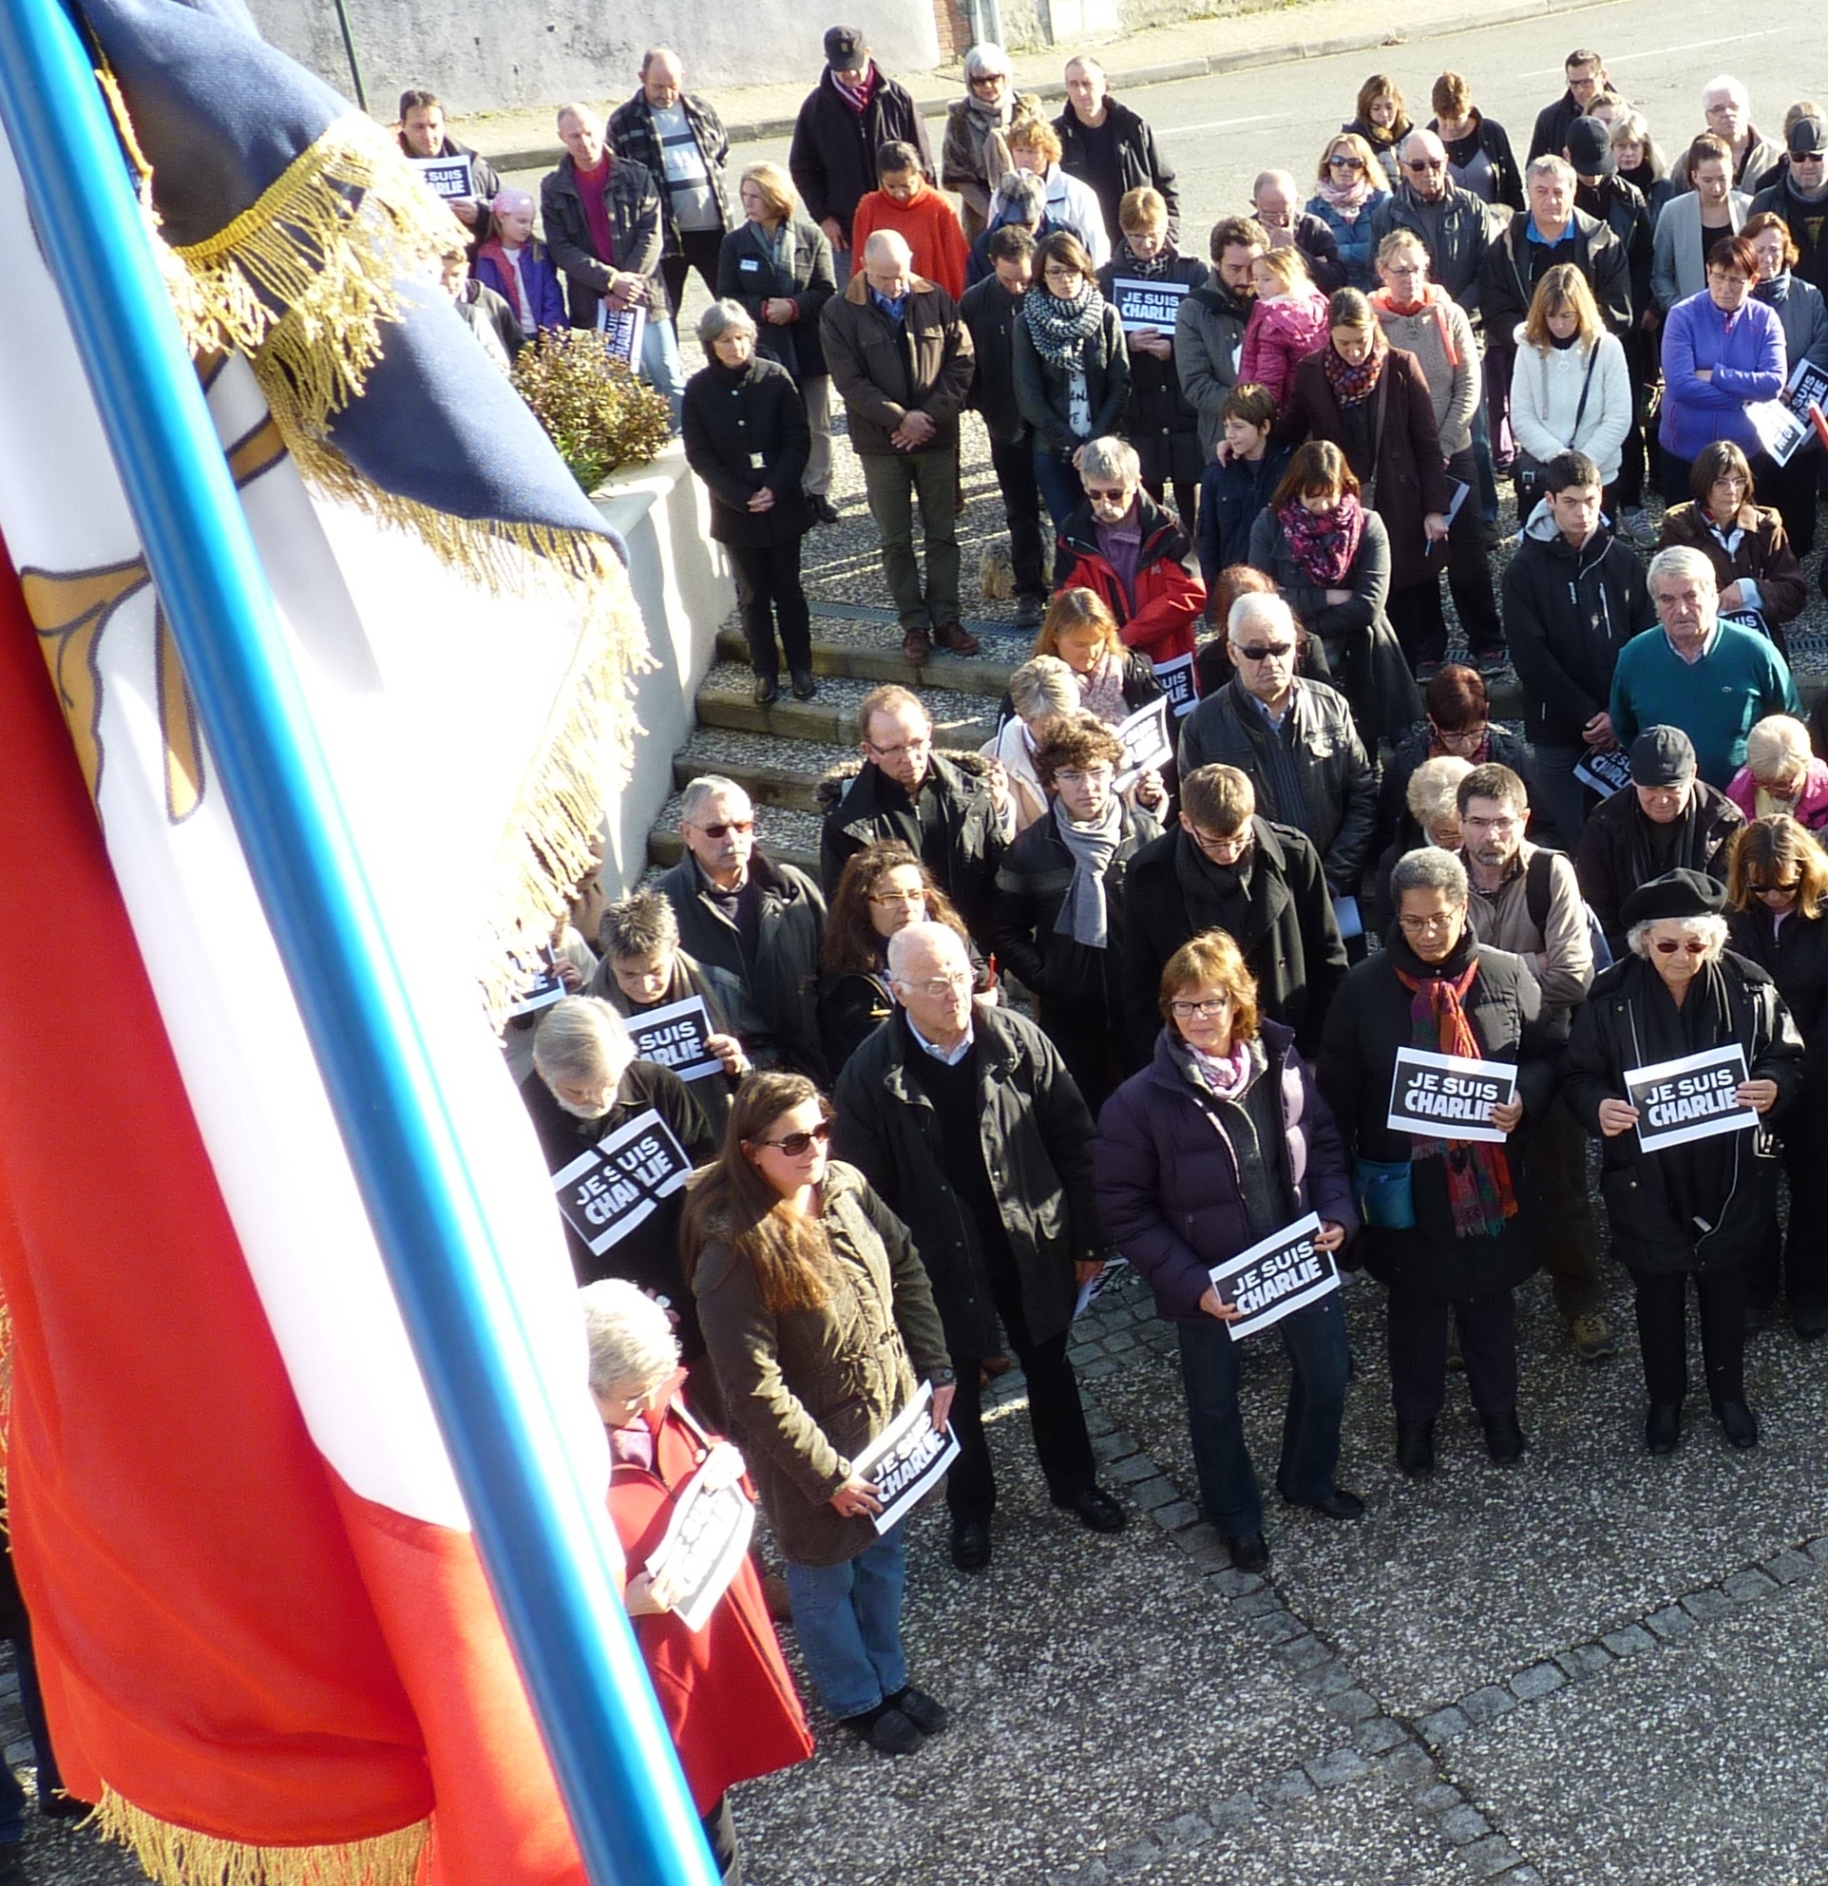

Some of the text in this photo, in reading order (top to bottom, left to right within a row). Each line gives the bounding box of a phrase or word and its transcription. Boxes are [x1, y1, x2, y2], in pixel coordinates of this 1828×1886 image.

[429, 169, 463, 182] SUIS
[1121, 303, 1179, 323] CHARLIE
[1122, 291, 1180, 307] JE SUIS
[1162, 672, 1188, 689] UIS
[639, 1021, 698, 1051] SUIS
[1408, 1072, 1499, 1100] JE SUIS
[1646, 1069, 1734, 1104] JE SUIS
[1405, 1089, 1497, 1121] CHARLIE
[1647, 1088, 1739, 1127] CHARLIE
[577, 1177, 602, 1205] JE
[1232, 1240, 1316, 1296] JE SUIS
[1236, 1256, 1324, 1316] CHARLIE
[873, 1452, 900, 1482] JE
[876, 1428, 945, 1505] CHARLIE
